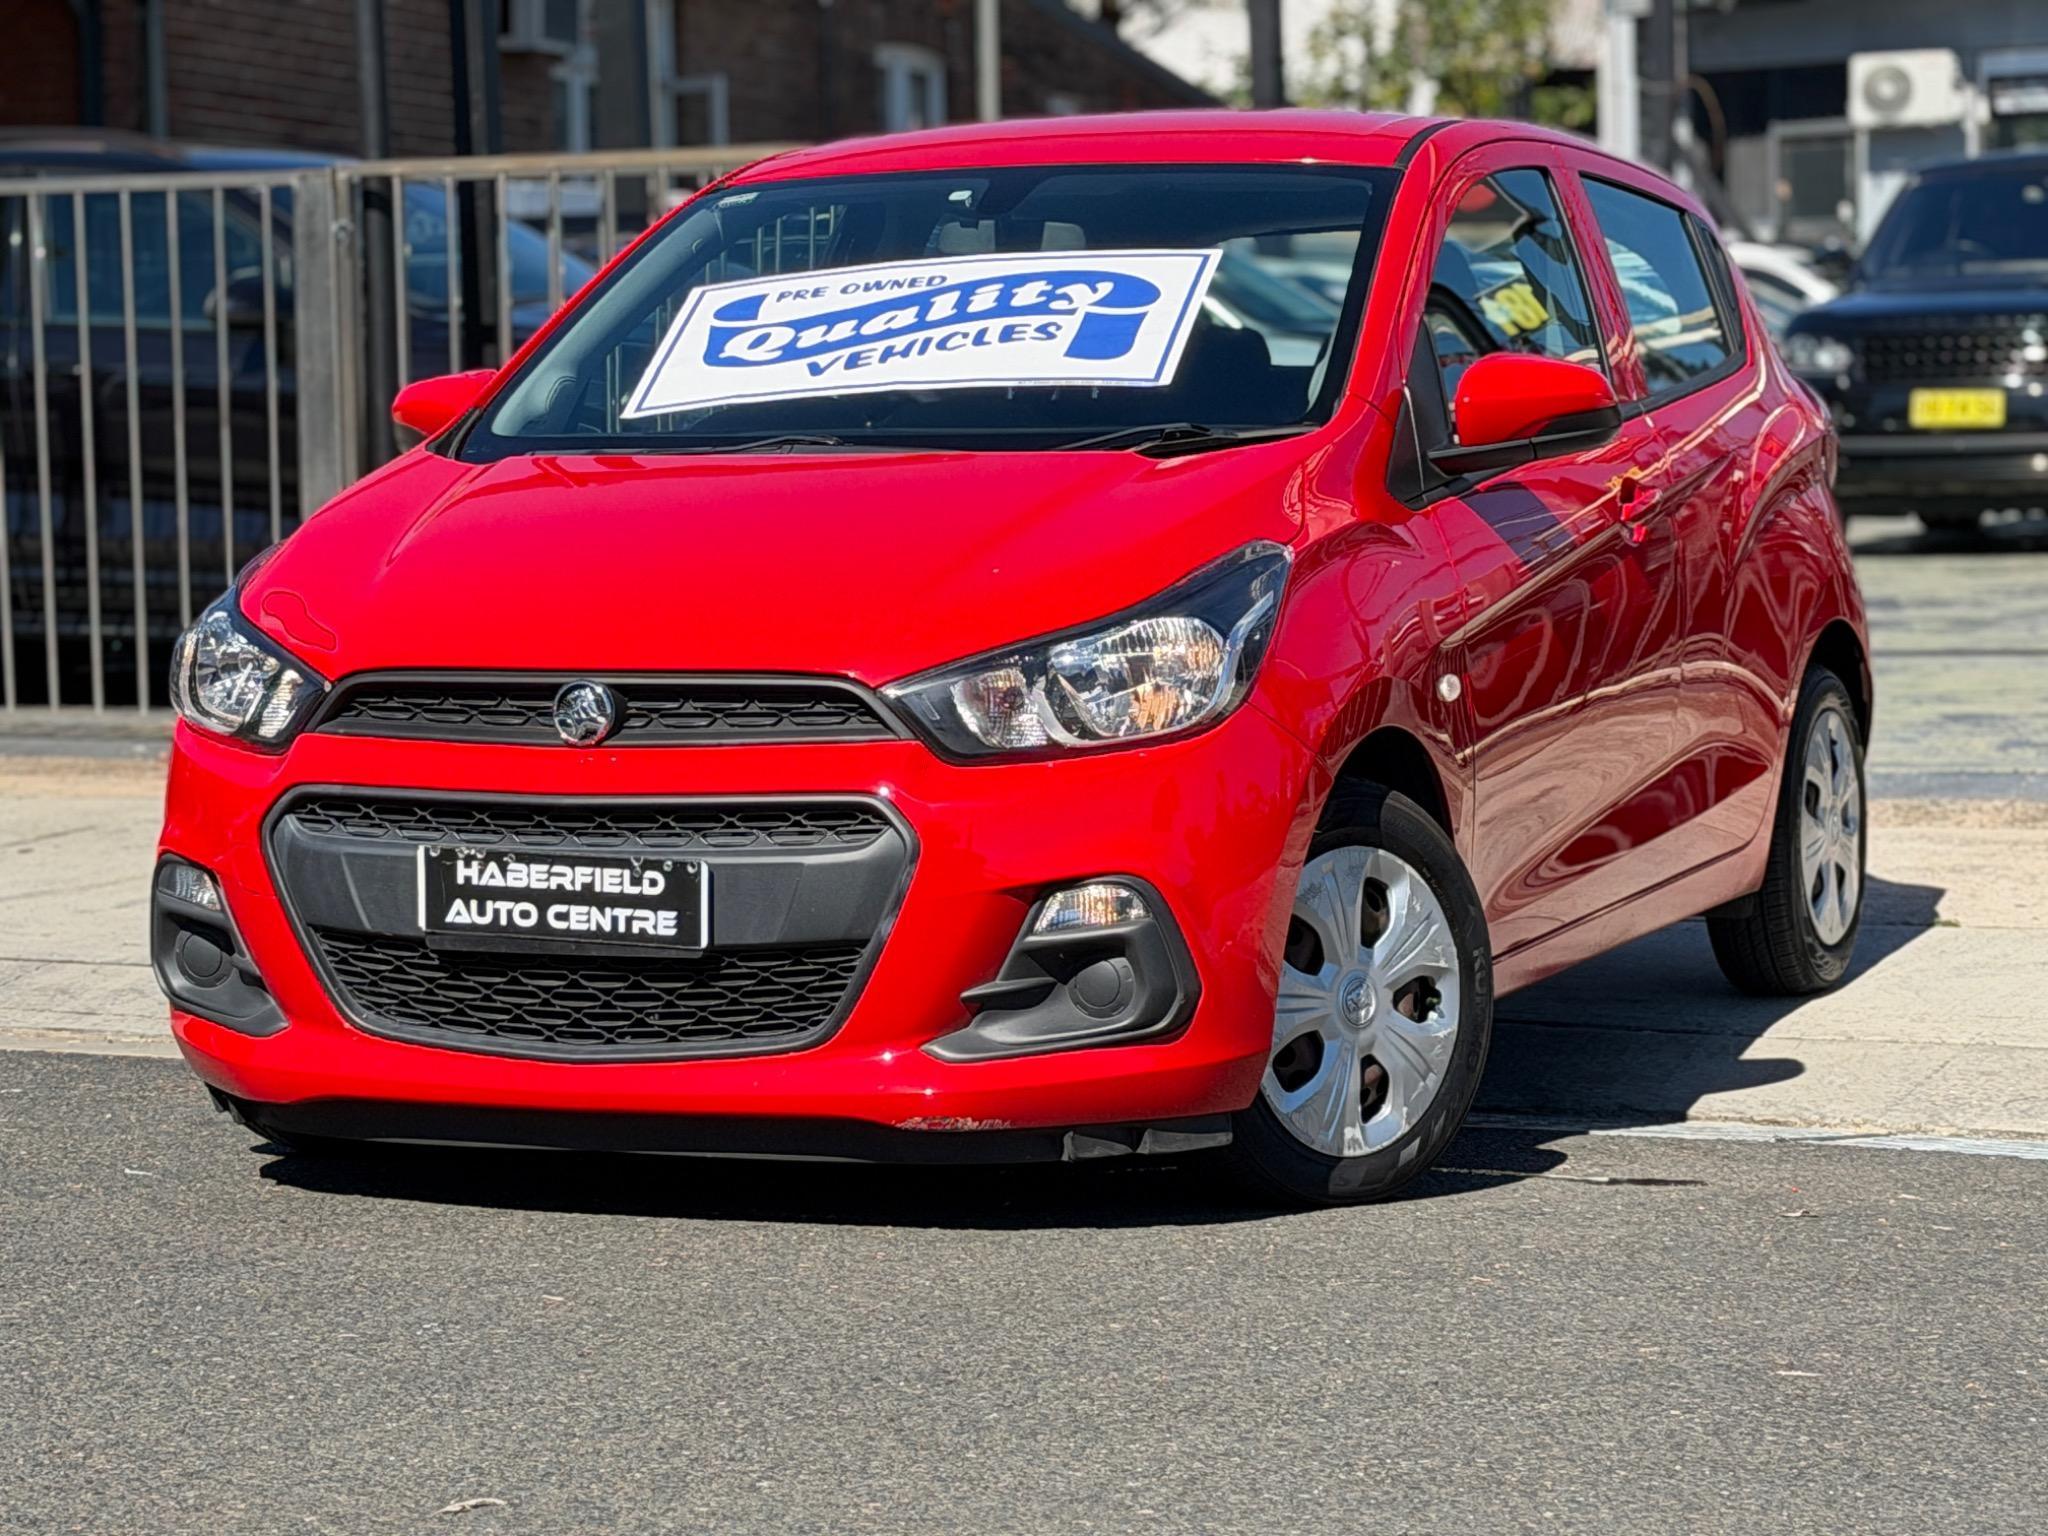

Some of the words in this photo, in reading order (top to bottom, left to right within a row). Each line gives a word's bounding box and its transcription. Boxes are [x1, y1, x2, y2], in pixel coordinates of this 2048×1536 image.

[776, 286, 829, 303] PRE
[840, 275, 948, 296] OWNED
[718, 280, 1115, 362] Quality
[806, 321, 1063, 377] VEHICLES
[456, 858, 666, 896] HABERFIELD
[444, 897, 539, 928] AUTO
[546, 903, 678, 936] CENTRE
